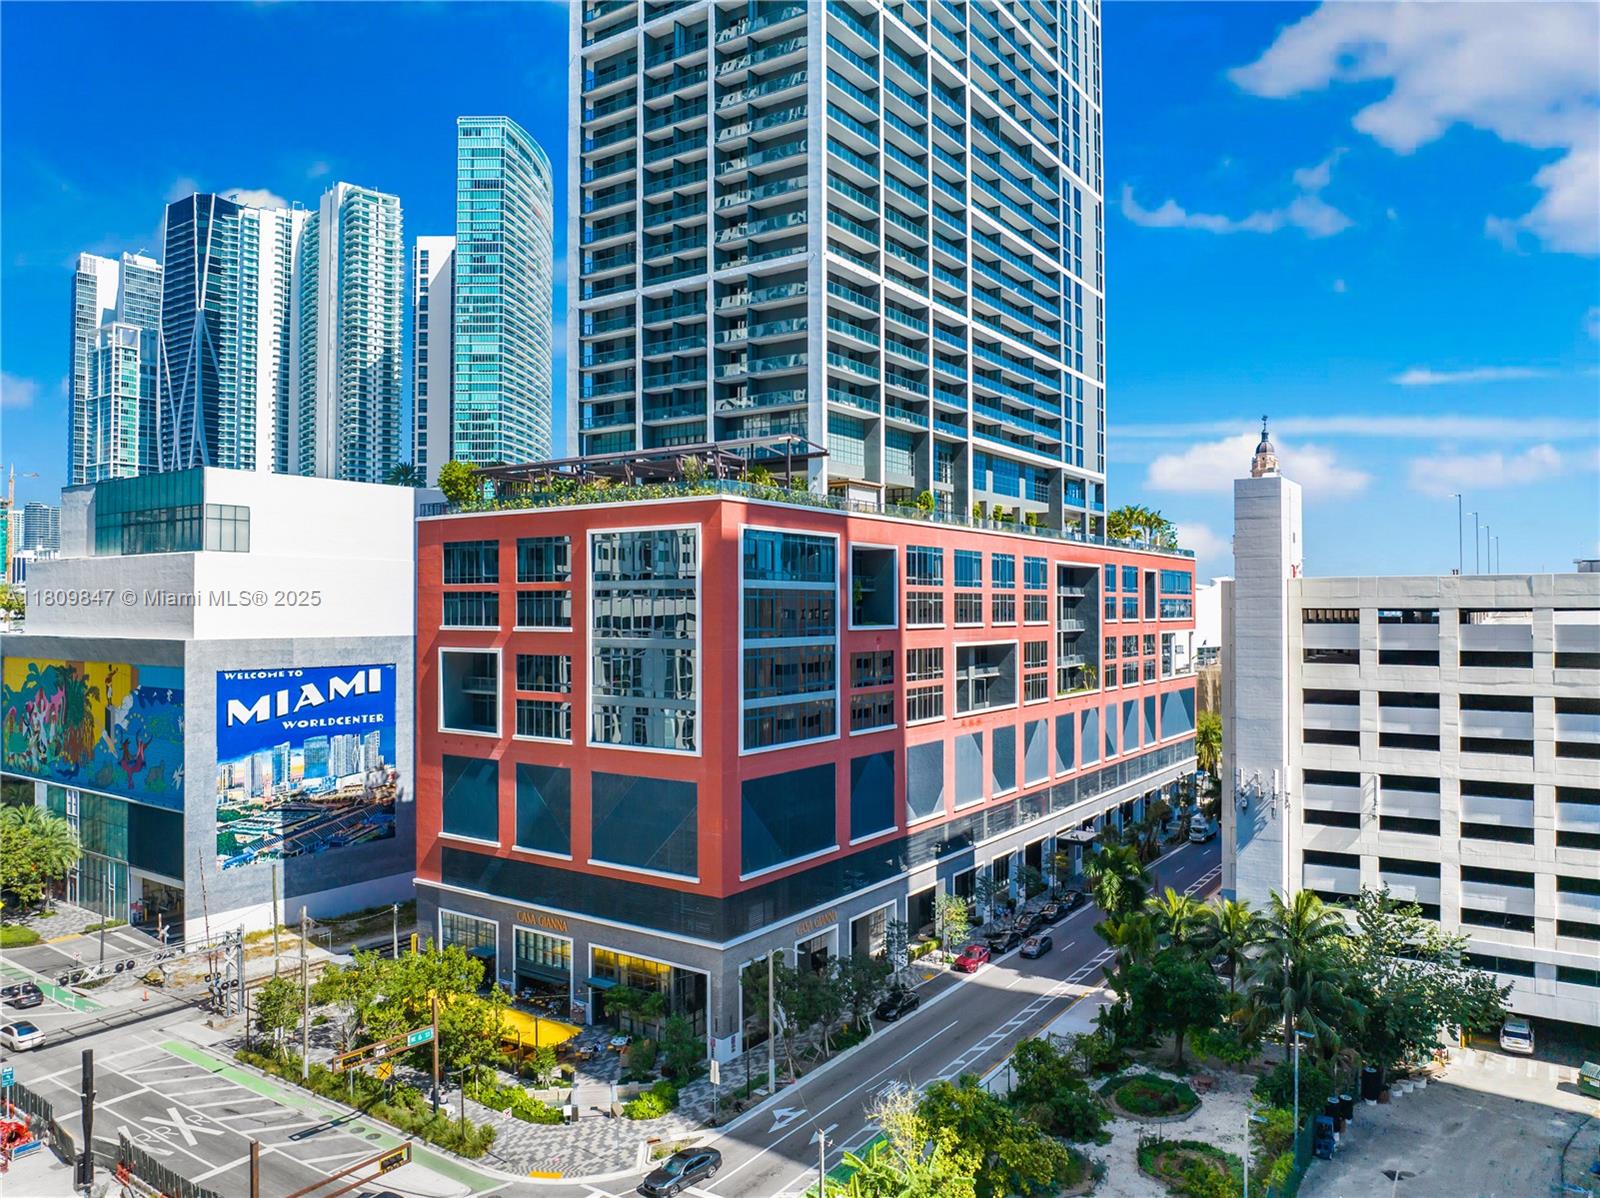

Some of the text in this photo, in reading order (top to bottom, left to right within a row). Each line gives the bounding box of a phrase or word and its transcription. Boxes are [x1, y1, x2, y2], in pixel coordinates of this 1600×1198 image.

[224, 670, 304, 680] WELCOME TO
[226, 668, 382, 727] MIAMI
[282, 713, 384, 730] WORLDCENTER
[516, 911, 569, 932] CASA GIANNA
